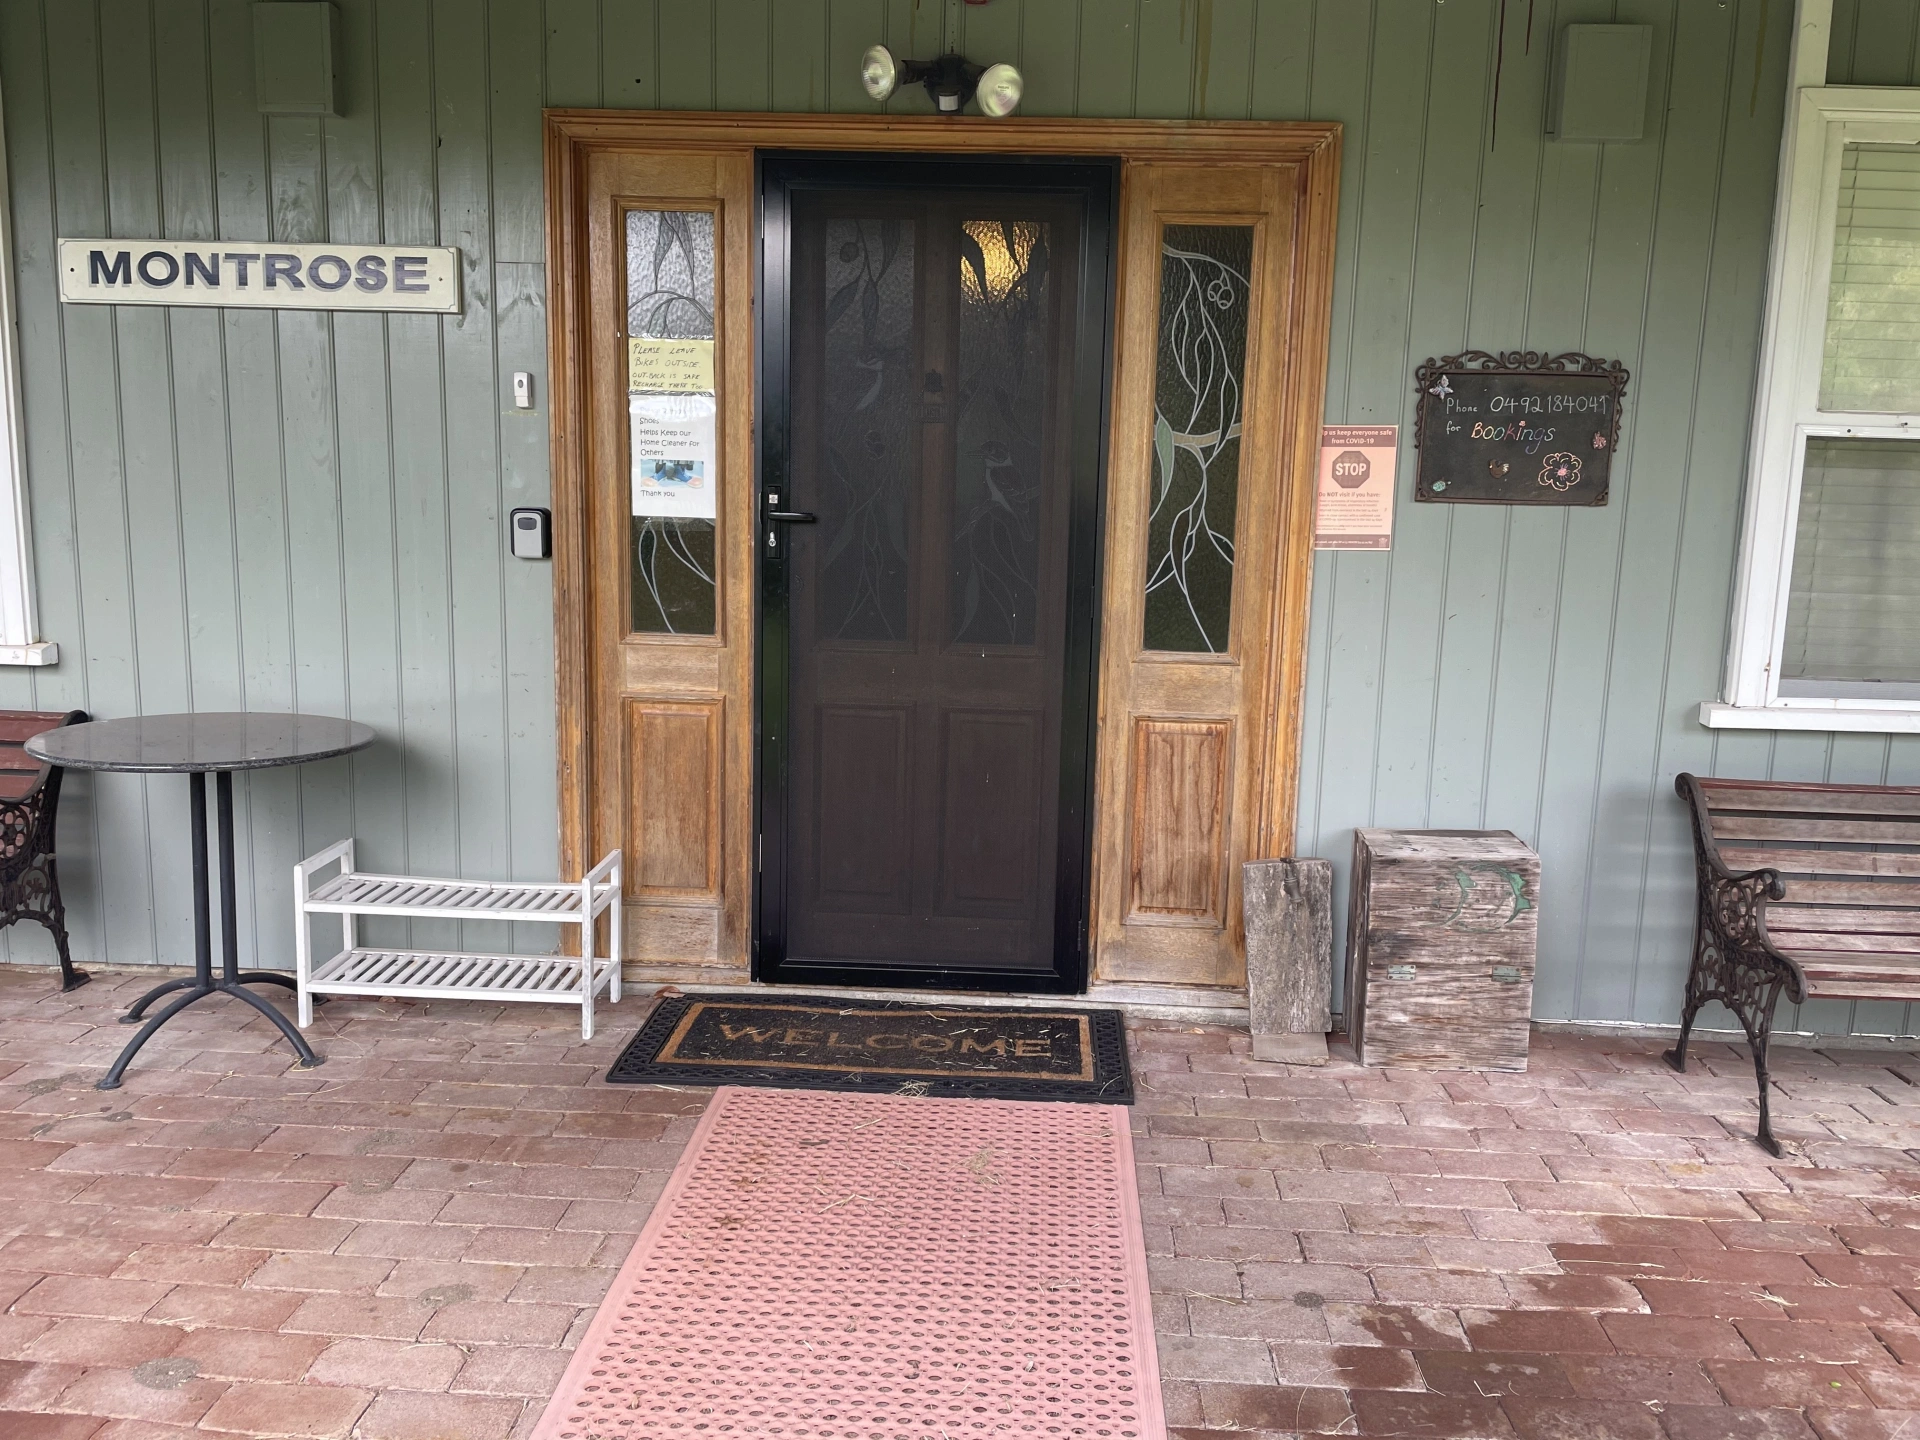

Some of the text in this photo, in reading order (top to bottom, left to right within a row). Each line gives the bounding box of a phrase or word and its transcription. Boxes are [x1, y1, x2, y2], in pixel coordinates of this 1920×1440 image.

[89, 250, 430, 293] MONTROSE
[633, 343, 660, 354] PLEASE
[633, 380, 664, 388] RECHARGE
[1446, 397, 1478, 414] Phone
[1446, 420, 1556, 454] for Bookings
[1335, 463, 1367, 476] STOP
[720, 1024, 1052, 1058] WELCOME
